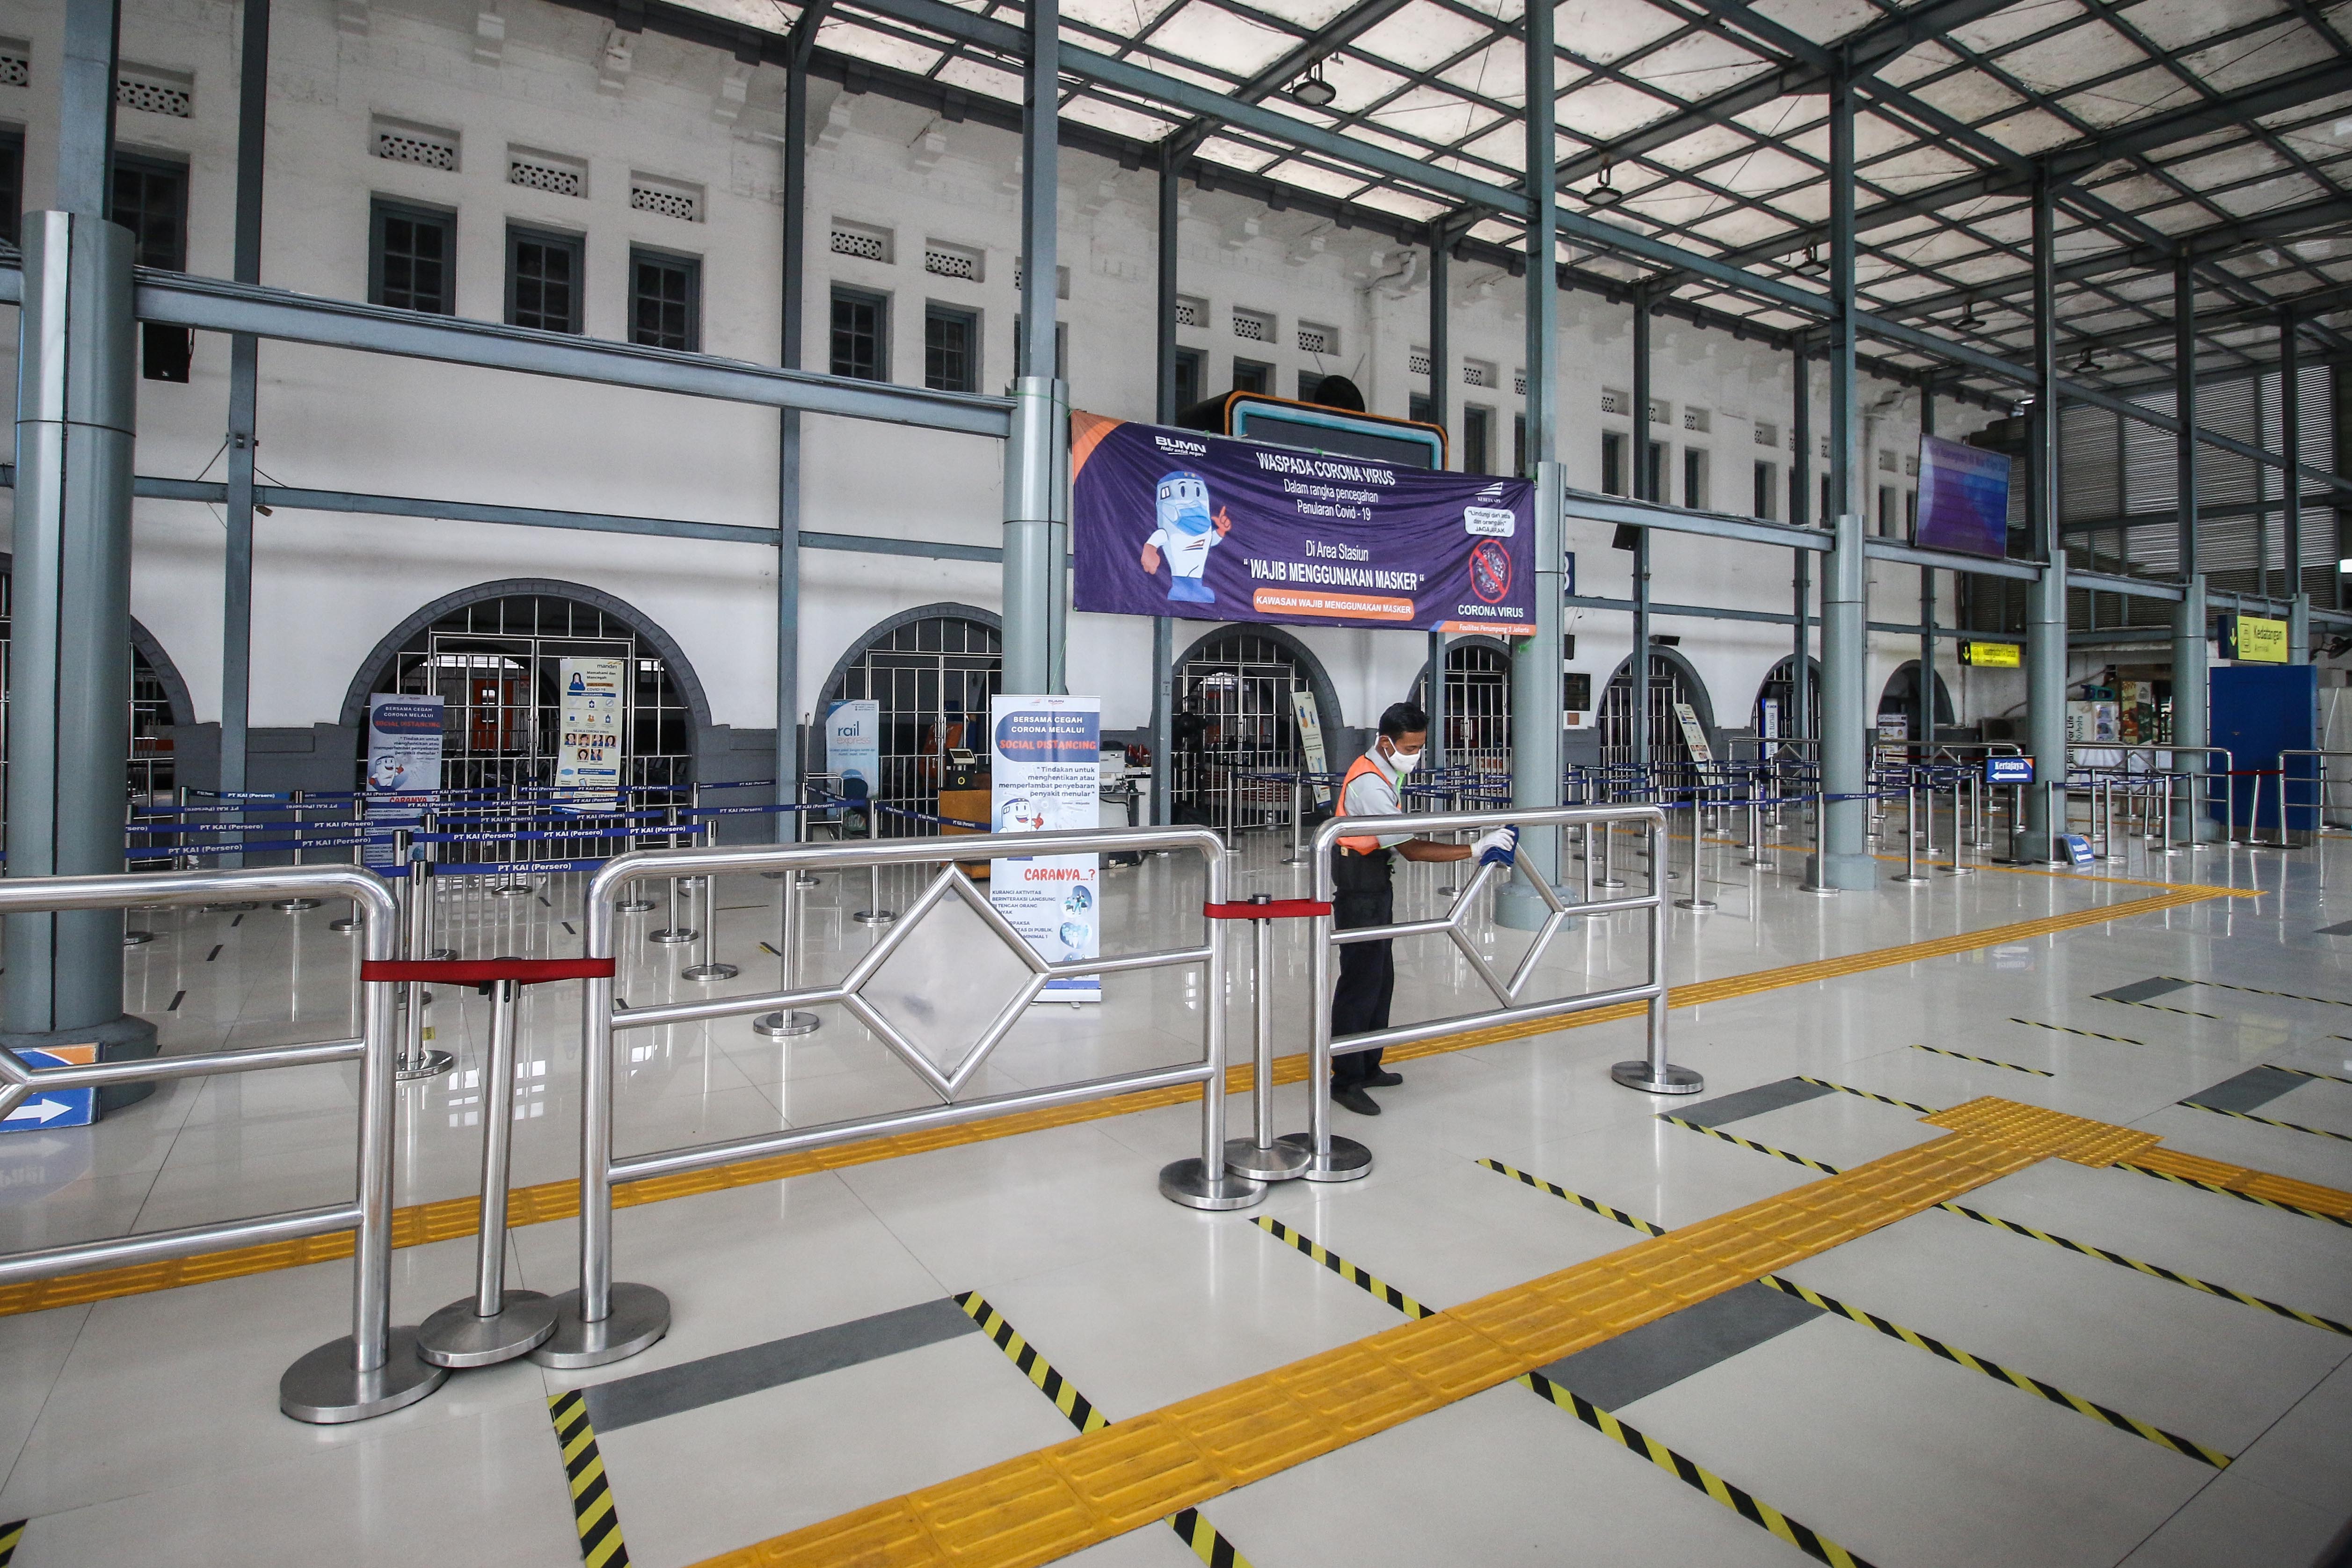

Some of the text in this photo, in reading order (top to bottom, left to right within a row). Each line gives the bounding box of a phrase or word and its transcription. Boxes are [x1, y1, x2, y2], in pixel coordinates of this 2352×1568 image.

[1155, 436, 1207, 453] BUMN
[1256, 452, 1396, 486] WASPADA CORONA VIRUS
[1284, 479, 1378, 504] Dalam rangka pencegahan
[1296, 499, 1371, 521] Penularan Covid 19
[1306, 540, 1369, 562] Di Area Stasiun
[1250, 559, 1417, 591] WAJIB MENGGUNAKAN MASKER
[1256, 595, 1411, 614] KAWASAN WAJIB MENGGUNAKAN MASKER
[1458, 605, 1523, 618] CORONA VIRUS
[838, 721, 859, 736] rail
[837, 737, 871, 746] express
[1000, 740, 1097, 750] SOCIAL DISTANCING
[1995, 762, 2024, 771] Kertajaya
[202, 844, 242, 853] (Persero)
[531, 863, 572, 871] (Persero)
